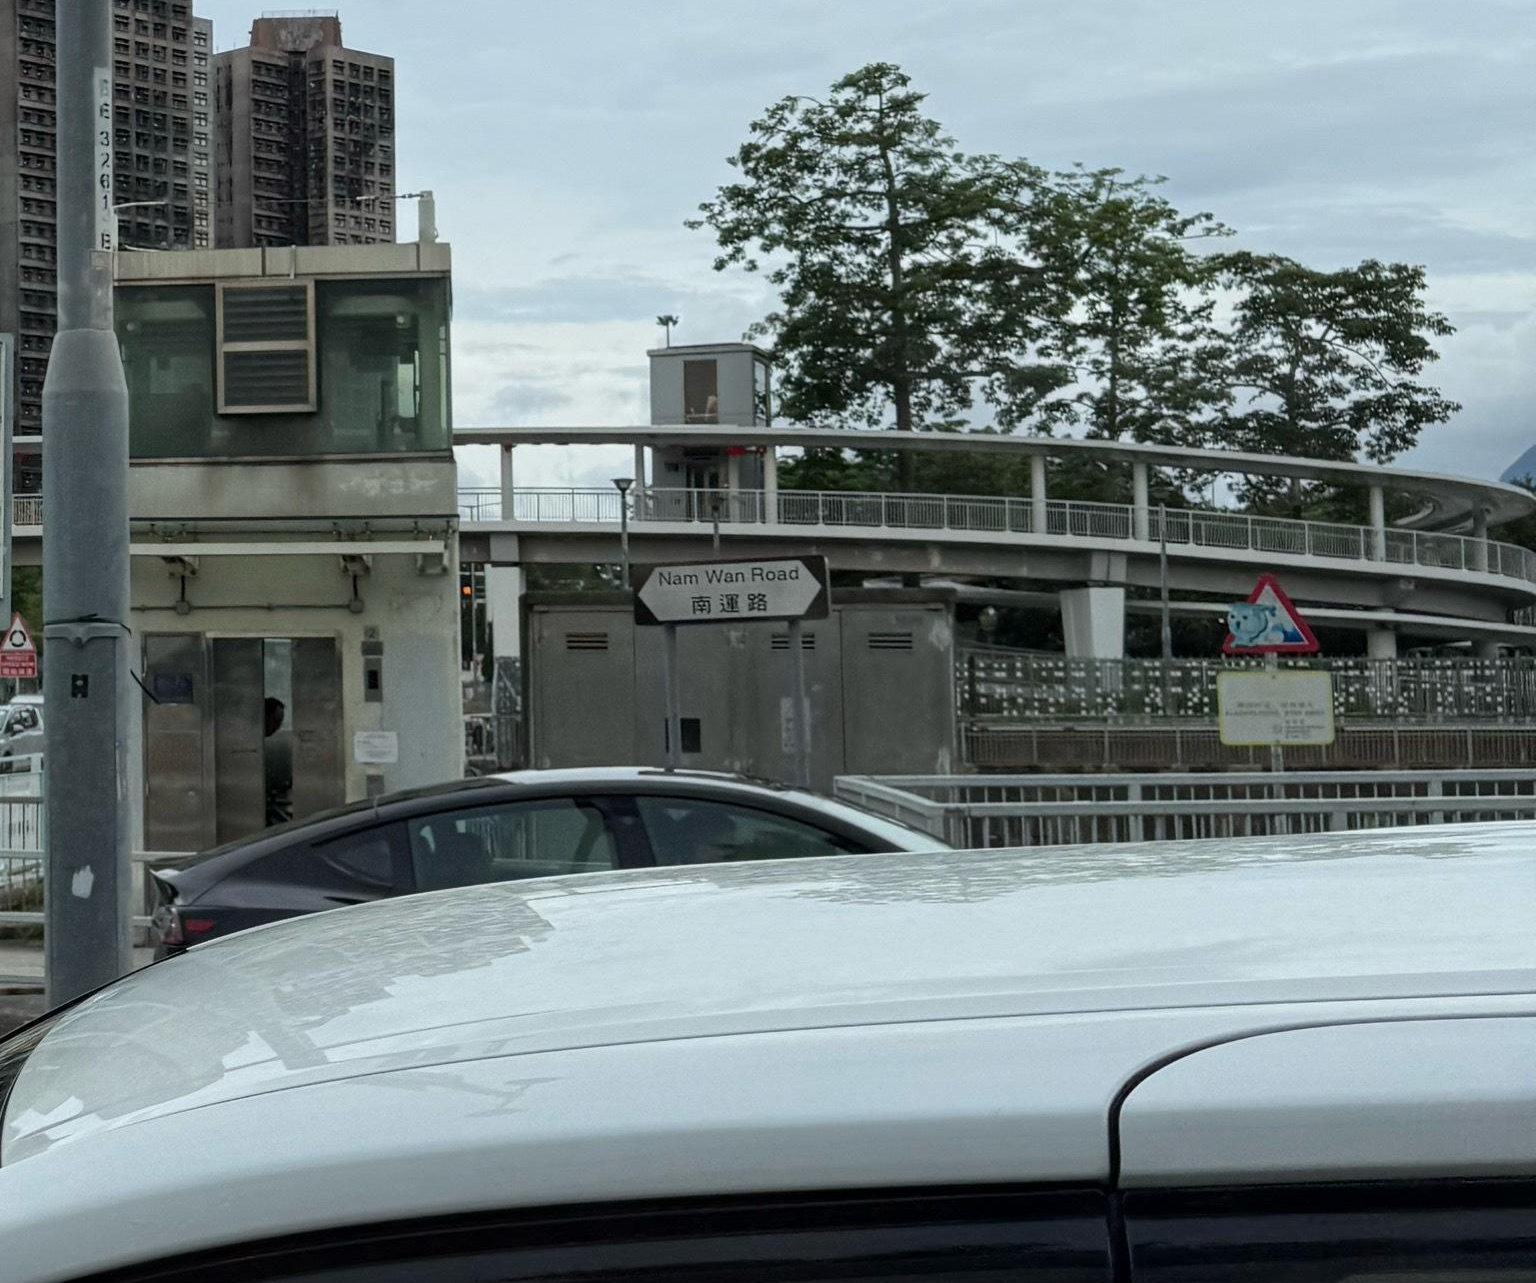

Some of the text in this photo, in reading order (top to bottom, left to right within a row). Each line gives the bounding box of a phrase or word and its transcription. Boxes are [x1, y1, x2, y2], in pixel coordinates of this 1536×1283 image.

[659, 567, 800, 586] Nam Wan Road
[691, 593, 769, 615] 南運路
